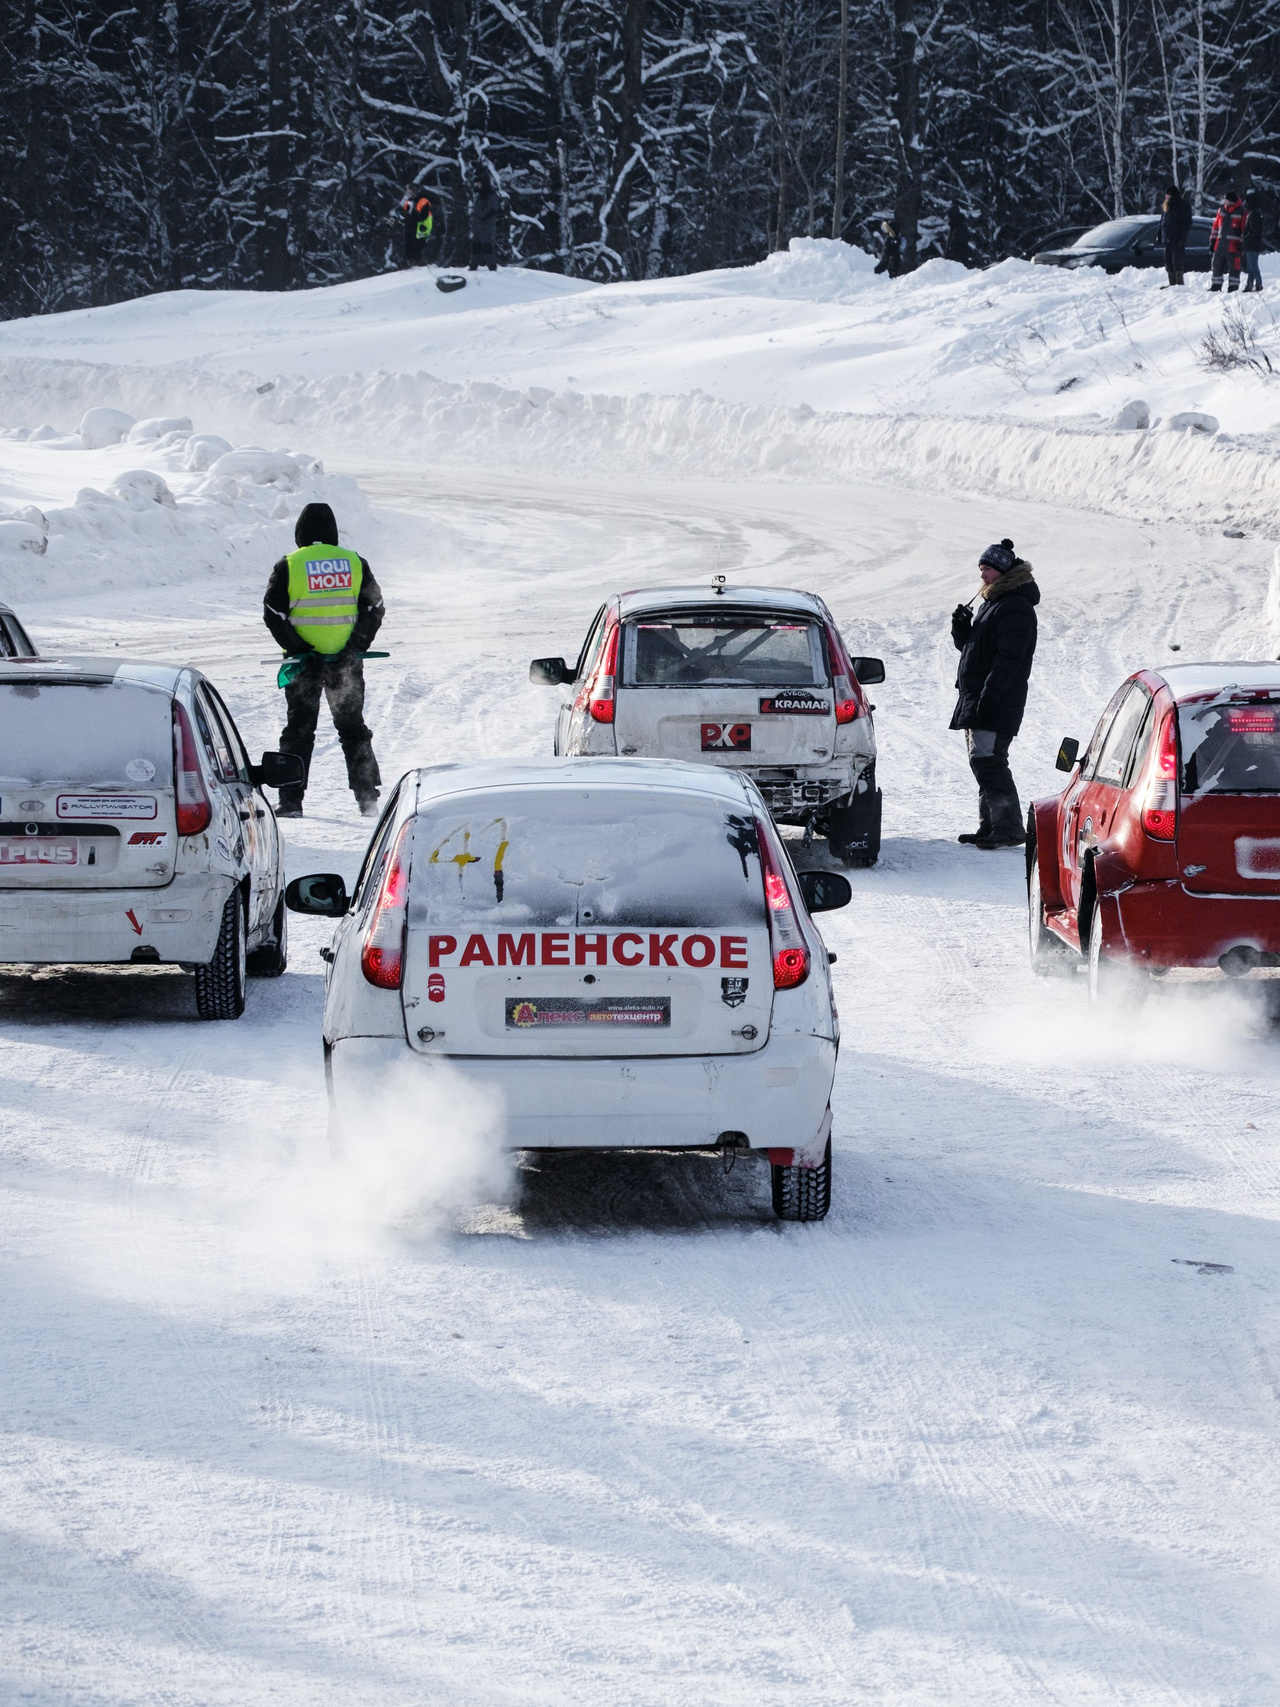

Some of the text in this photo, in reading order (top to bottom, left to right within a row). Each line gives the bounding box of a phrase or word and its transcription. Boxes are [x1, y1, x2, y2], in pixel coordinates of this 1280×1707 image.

[308, 560, 350, 575] LIQUI
[310, 573, 351, 589] MOLY
[774, 699, 829, 710] KRAMAR
[70, 803, 153, 812] RALLYNAVIGATOR
[9, 845, 73, 861] PLUS
[428, 932, 748, 969] РАМЕНСКОЕ
[515, 1004, 661, 1024] Алекс автотехцентр
